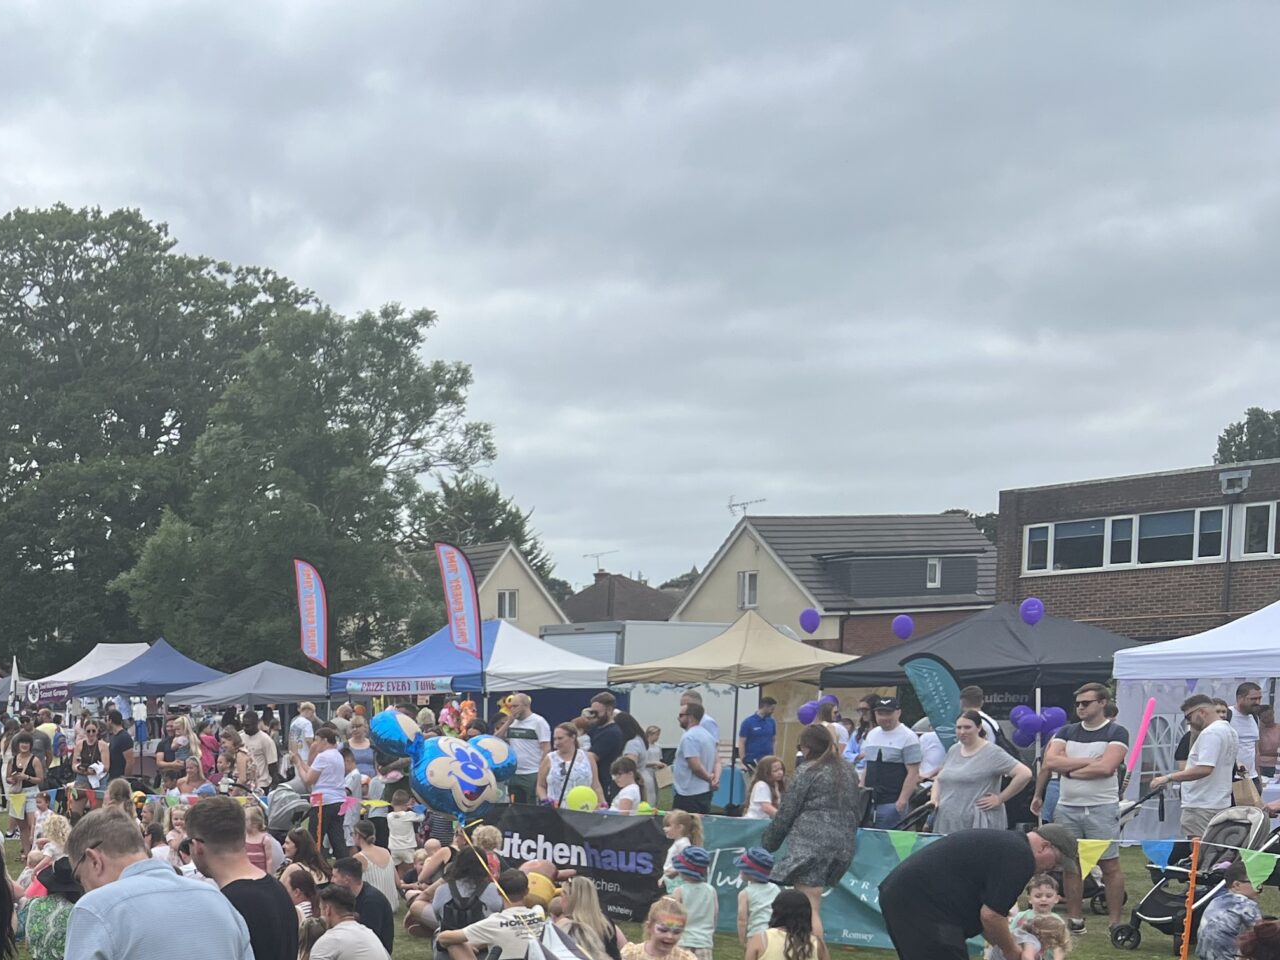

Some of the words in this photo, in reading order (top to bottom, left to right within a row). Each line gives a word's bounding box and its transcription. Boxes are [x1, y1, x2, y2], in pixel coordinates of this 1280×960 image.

[361, 681, 384, 692] PRIZE
[386, 680, 411, 692] EVERY
[415, 680, 436, 691] TIME
[53, 689, 68, 698] Group
[607, 904, 633, 917] Whiteley
[841, 928, 875, 942] Romsey
